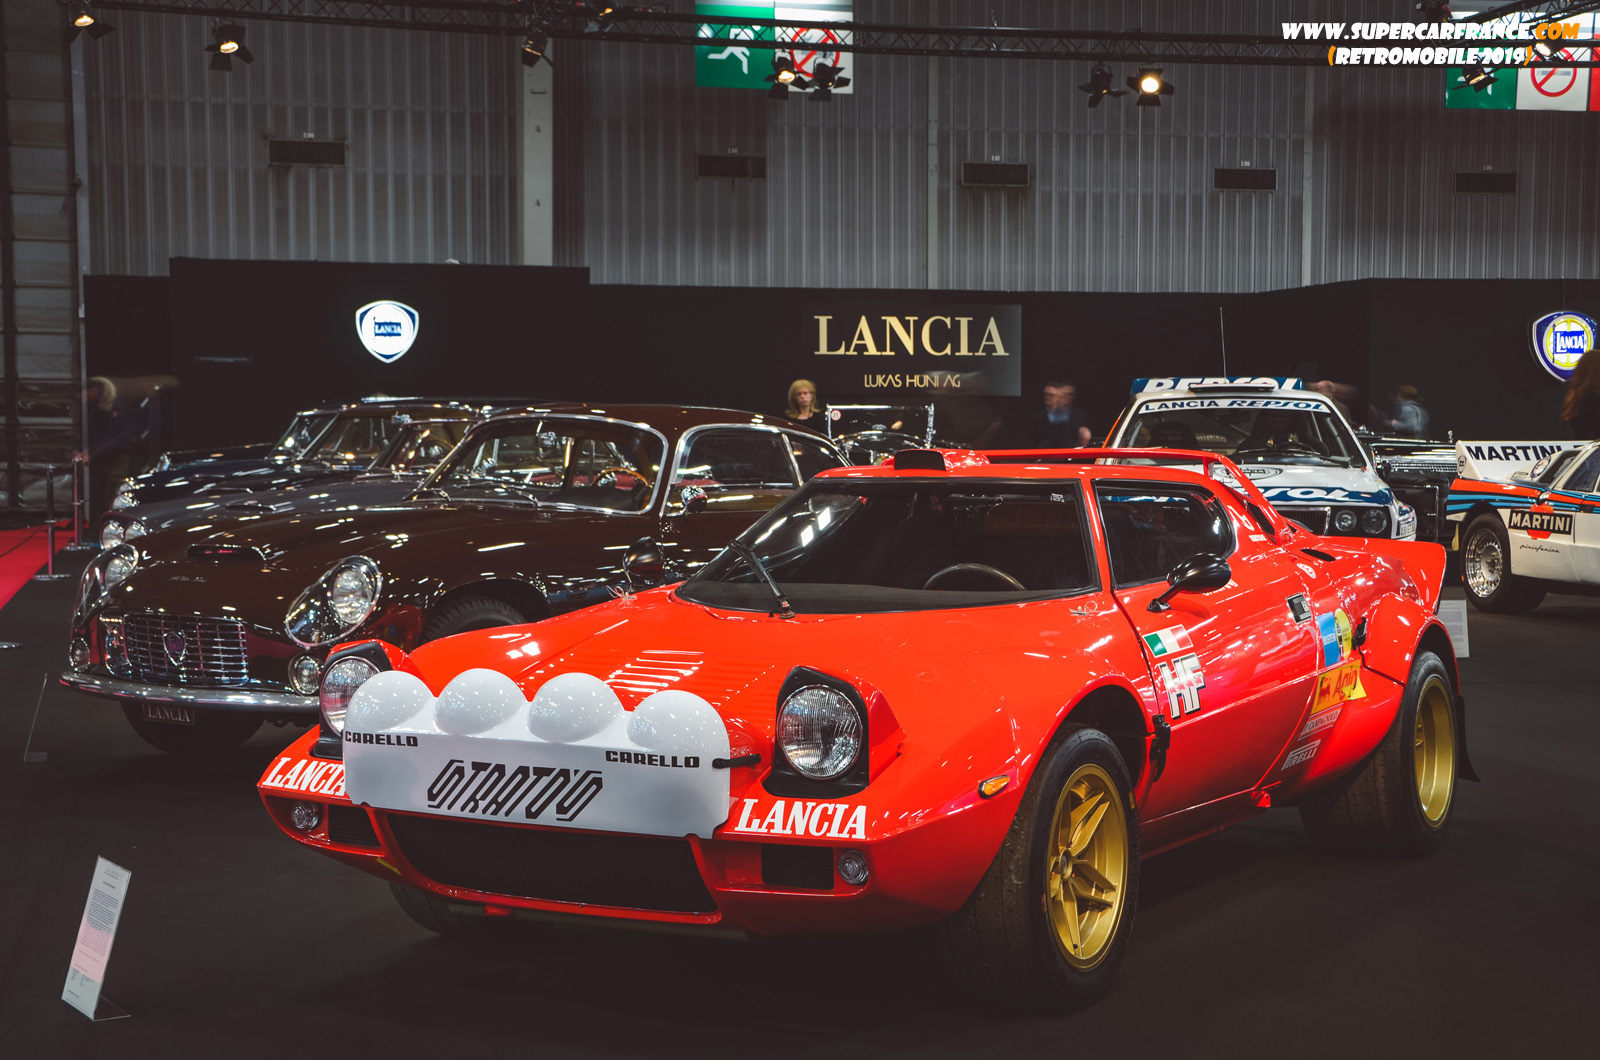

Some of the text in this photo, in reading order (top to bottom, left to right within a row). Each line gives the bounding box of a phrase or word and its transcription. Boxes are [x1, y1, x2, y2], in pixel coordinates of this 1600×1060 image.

[374, 323, 402, 334] LANCIA
[814, 315, 1009, 356] LANCIA
[864, 374, 902, 388] LUKAS
[943, 374, 961, 388] AG
[1144, 399, 1324, 412] LANCIA REPSOL
[1510, 512, 1571, 532] MARTINI
[1158, 652, 1206, 720] HF
[148, 704, 191, 722] LANCIA
[345, 731, 419, 747] CARELLO
[605, 750, 700, 768] CARELLO
[1281, 738, 1321, 771] PIRELLI
[262, 756, 345, 796] LANCIA
[734, 798, 867, 839] LANCIA
